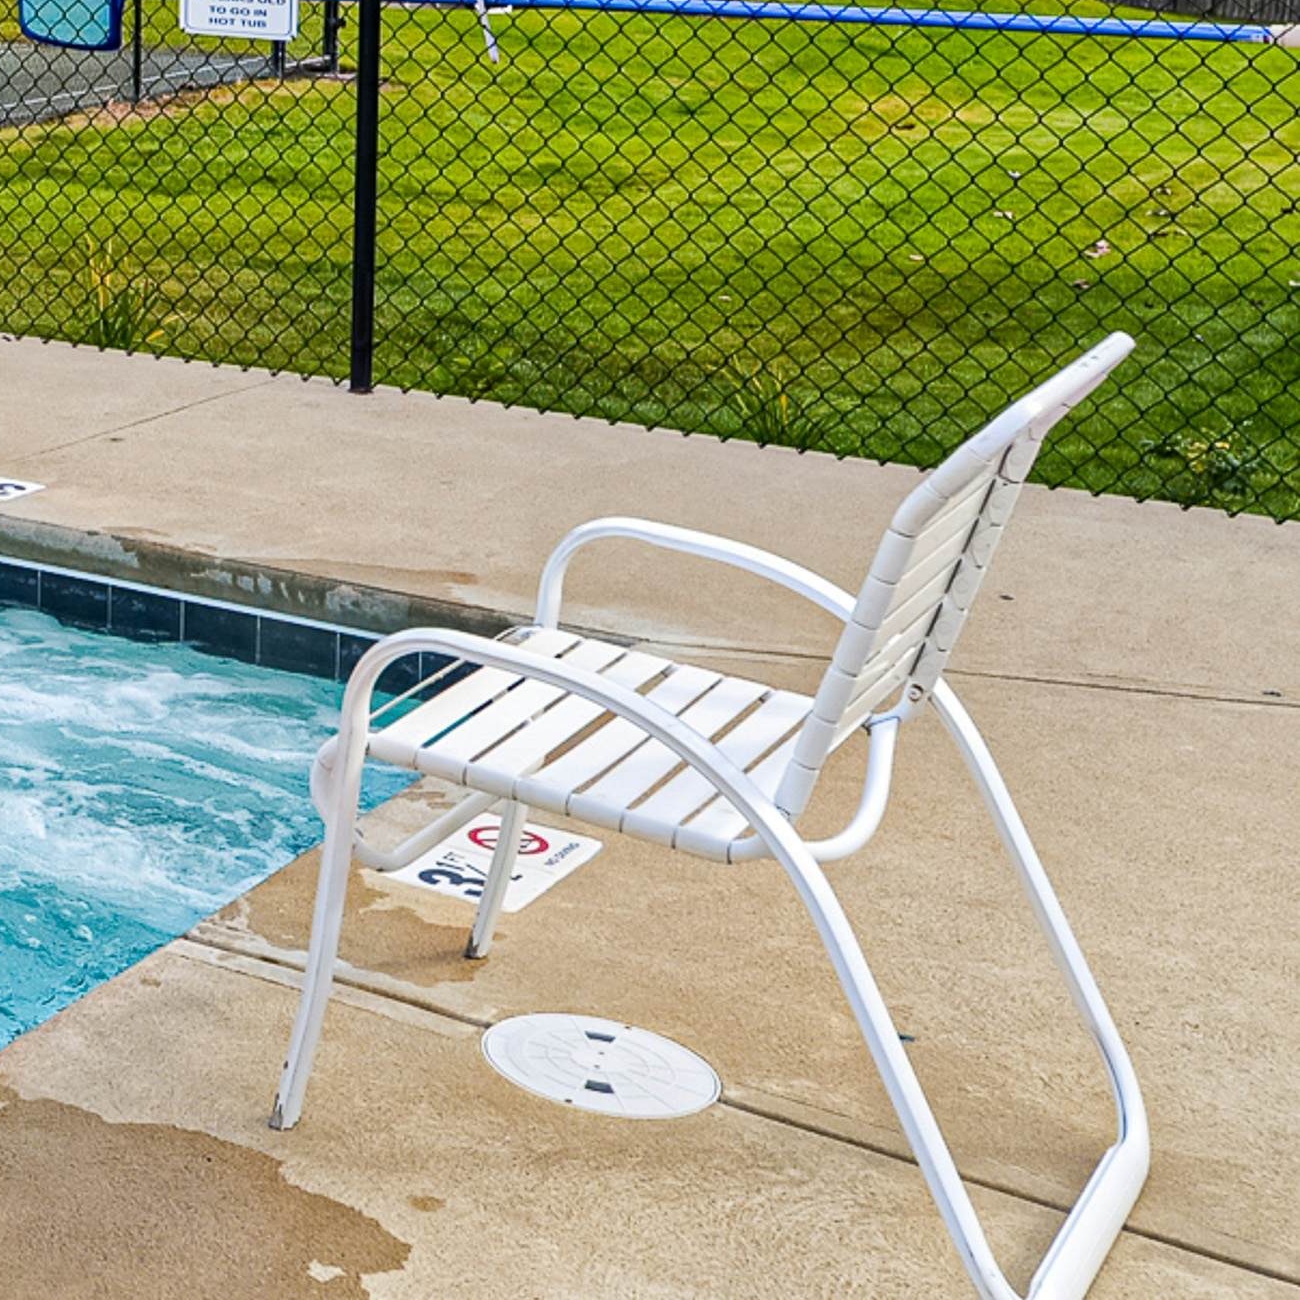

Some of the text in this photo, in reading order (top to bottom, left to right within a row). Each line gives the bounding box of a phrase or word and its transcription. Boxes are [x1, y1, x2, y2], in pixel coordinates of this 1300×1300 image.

[209, 5, 267, 17] TO GO IN
[209, 17, 267, 28] HOT TUB
